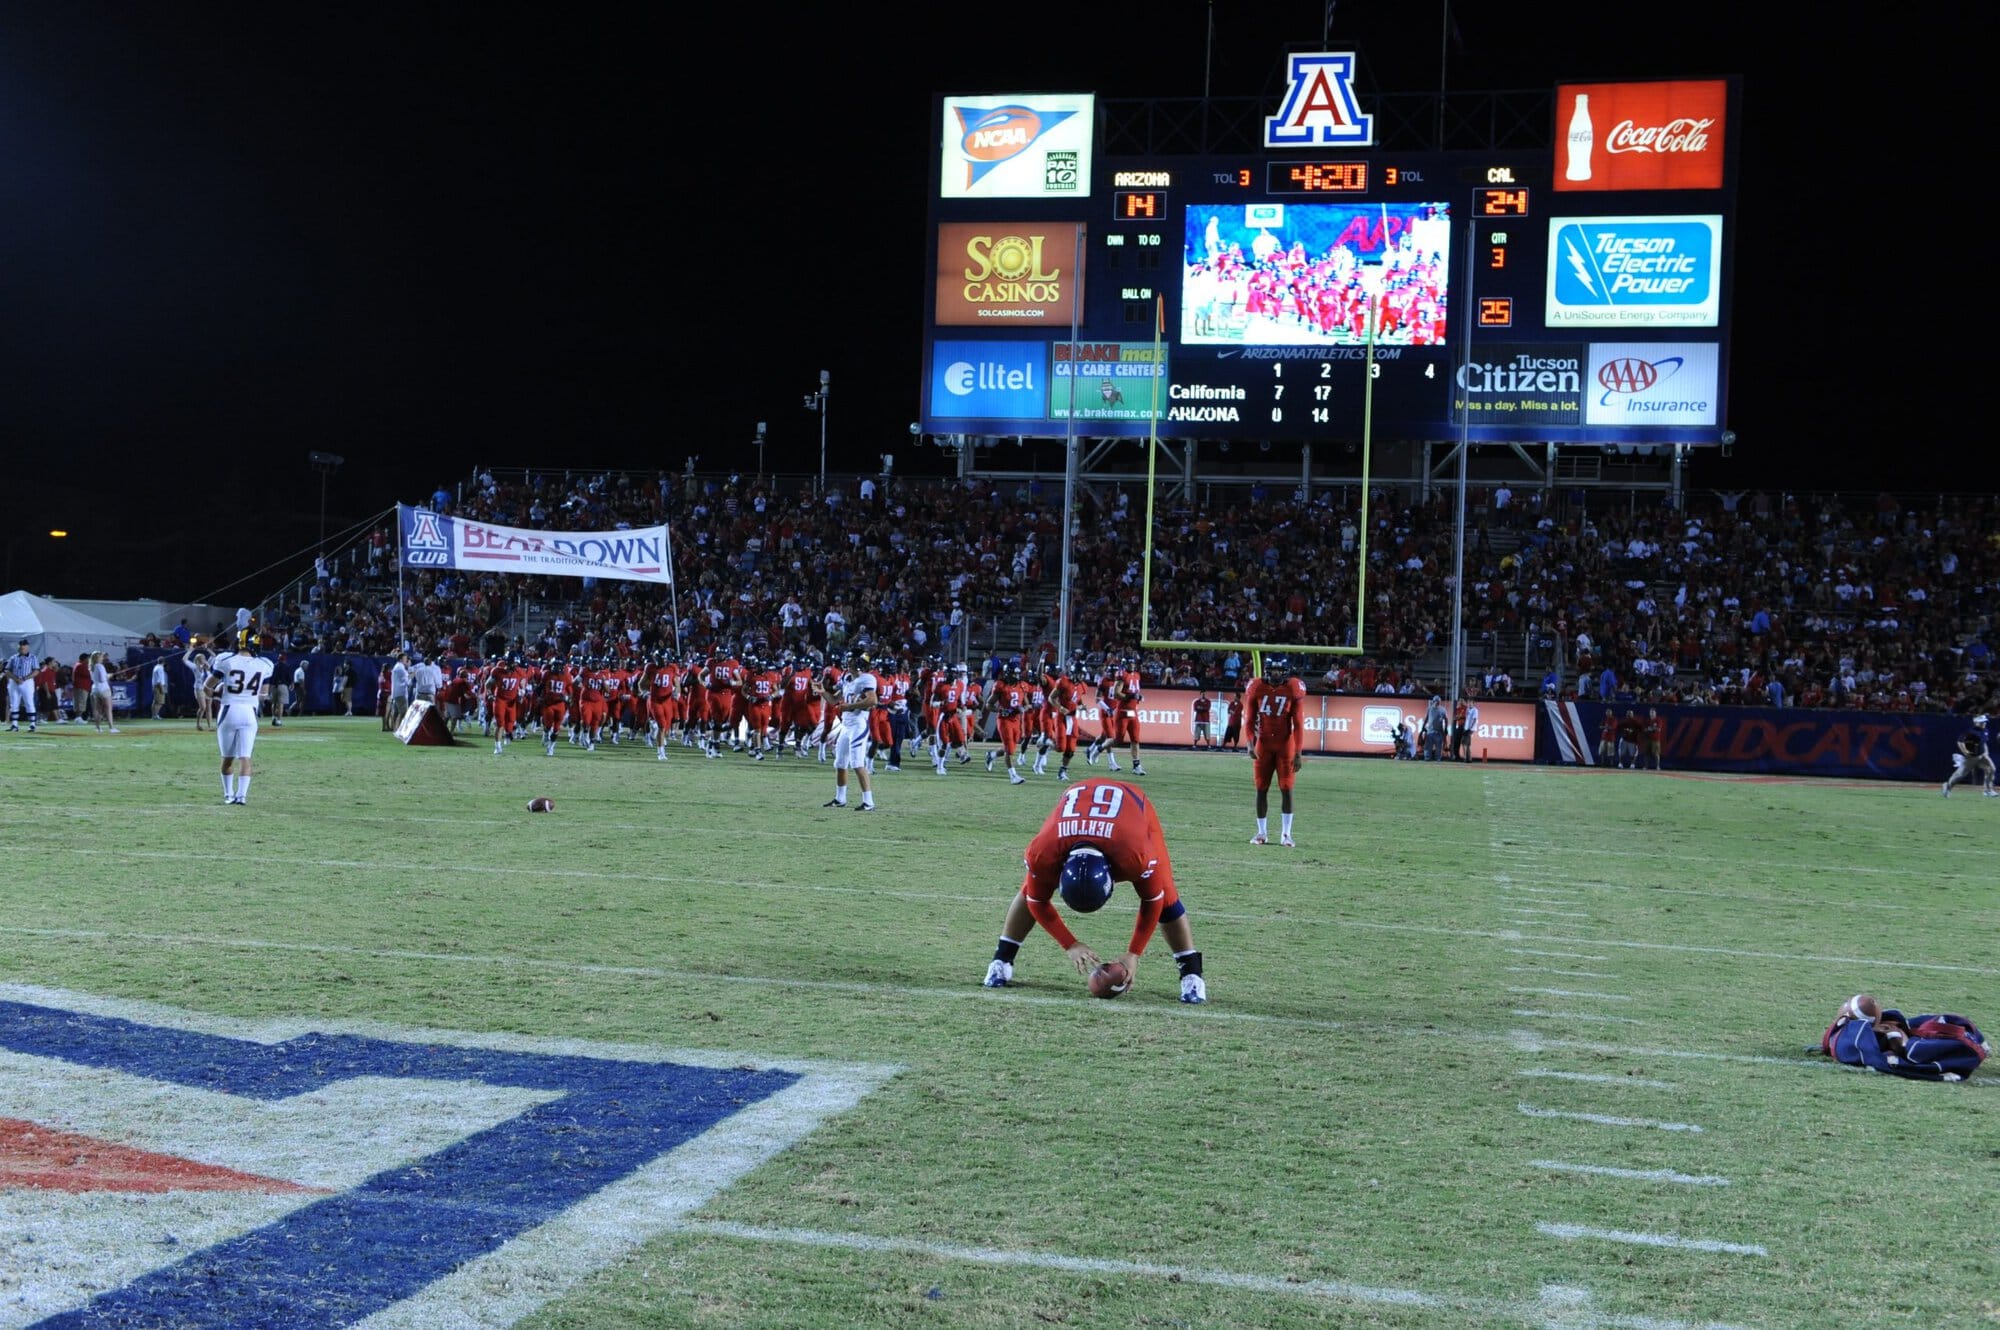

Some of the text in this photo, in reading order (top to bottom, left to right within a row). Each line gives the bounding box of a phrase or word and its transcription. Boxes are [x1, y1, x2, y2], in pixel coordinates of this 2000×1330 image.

[1263, 52, 1374, 148] A
[974, 128, 1026, 148] NCAA
[1606, 118, 1715, 153] Coca-Cola
[1047, 161, 1076, 170] PAC
[1047, 170, 1076, 183] 10
[1114, 172, 1170, 187] ARIZONA
[1213, 174, 1236, 184] TOL
[1239, 170, 1250, 186] 3
[1291, 165, 1366, 190] 4:20
[1386, 168, 1397, 184] 3
[1401, 171, 1424, 182] TOL
[1487, 168, 1515, 183] CAL
[1127, 194, 1155, 216] 14
[1485, 191, 1526, 214] 24
[1107, 235, 1124, 245] DWN
[1138, 235, 1161, 245] TO GO
[1491, 233, 1507, 244] QTR
[1595, 233, 1675, 253] Tucson
[965, 236, 1060, 281] SOL
[1491, 249, 1504, 267] 3
[1602, 254, 1696, 273] Electric
[1611, 274, 1694, 293] Power
[963, 283, 1060, 302] CASINOS
[1122, 289, 1152, 299] BALL ON
[977, 309, 1044, 317] SOLCASINOS.COM
[1481, 301, 1510, 323] 25
[1553, 310, 1708, 321] A UniSource Energy Company
[1082, 364, 1112, 376] CARE
[1517, 355, 1578, 370] Tucson
[950, 361, 1033, 393] alltel
[1273, 363, 1435, 378] 1 2 3 4
[1456, 362, 1580, 393] Citizen
[1601, 358, 1655, 392] AAA
[1169, 385, 1332, 400] California 7 17
[1484, 402, 1492, 410] a
[1497, 400, 1517, 413] day.
[1521, 400, 1548, 410] Miss
[1551, 402, 1558, 410] a
[1561, 400, 1579, 411] lot.
[1627, 398, 1708, 412] Insurance
[1167, 407, 1330, 423] ARIZONA 0 14
[407, 509, 448, 549] A
[407, 551, 448, 565] CLUB
[553, 537, 660, 565] DOWN
[523, 554, 538, 562] THE
[541, 555, 586, 566] TRADITION
[655, 673, 669, 687] 48
[715, 666, 729, 680] 66
[227, 670, 262, 696] 34
[755, 680, 769, 693] 35
[1010, 691, 1018, 706] 2
[1260, 695, 1287, 717] 47
[1138, 710, 1182, 725] arm
[1303, 716, 1349, 732] arm
[1478, 724, 1524, 739] arm
[1062, 785, 1124, 819] 61
[1058, 820, 1114, 838] BERTONI
